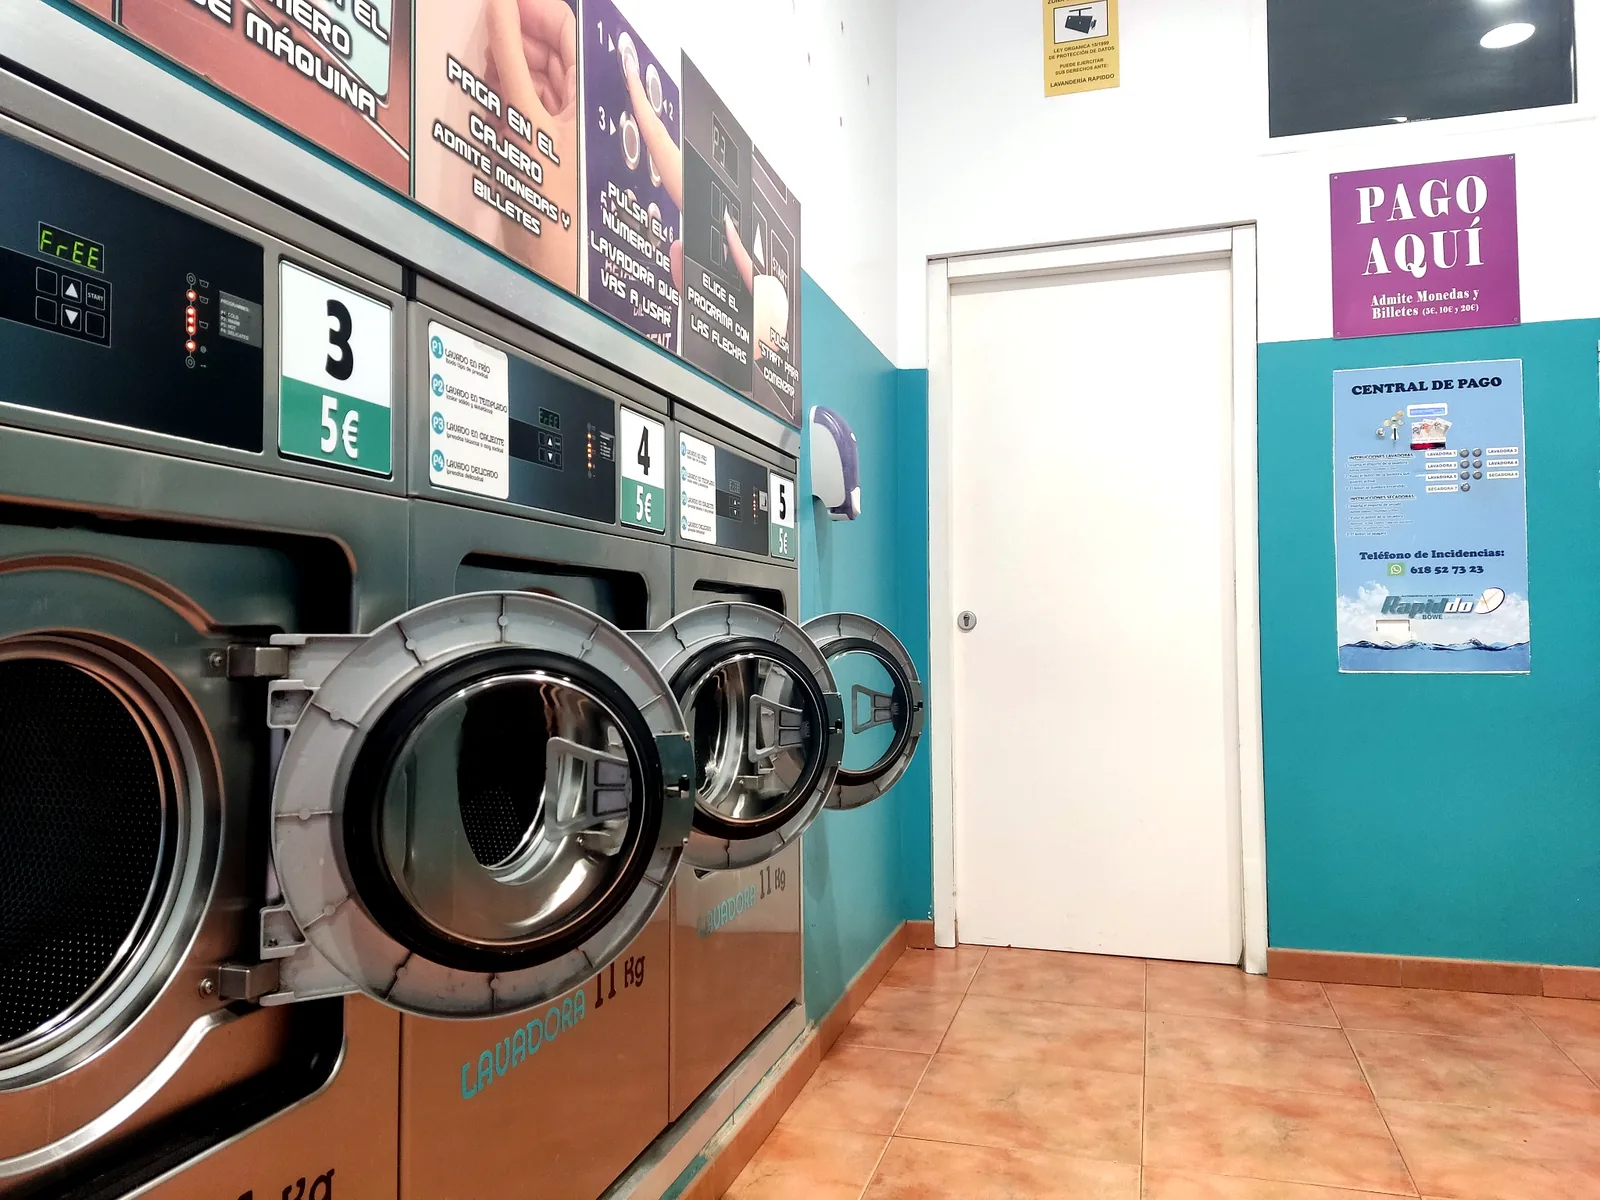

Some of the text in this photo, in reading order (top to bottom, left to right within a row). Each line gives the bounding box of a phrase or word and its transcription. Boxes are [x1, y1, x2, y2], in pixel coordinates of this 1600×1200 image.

[353, 0, 388, 41] EL
[597, 20, 603, 45] 1
[246, 12, 376, 118] MÁQUINA
[1056, 49, 1089, 59] PROTECCIÓN
[1098, 45, 1115, 53] DATOS
[1059, 58, 1104, 69] PUEDE EJERCITAR
[1065, 65, 1094, 74] DERECHOS
[1050, 73, 1115, 88] LAVANDERÍA RAPIDDO
[447, 57, 561, 165] PAGA EN EL
[598, 105, 606, 131] 3
[669, 101, 674, 122] 2
[469, 114, 543, 185] CAJERO
[433, 122, 571, 229] ADMITE MONEDAS Y
[473, 177, 542, 236] BILLETES
[608, 180, 667, 243] PULSA EL
[1355, 175, 1488, 225] PAGO
[40, 228, 100, 270] FrEE
[602, 207, 671, 274] NÚMERO DE
[1361, 216, 1485, 279] AQUÍ
[590, 230, 680, 307] LAVADORA QUE
[87, 291, 105, 302] START
[600, 268, 627, 300] VAS
[630, 288, 640, 308] A
[642, 295, 672, 329] USAR
[702, 272, 740, 313] ELIGE EL
[1370, 287, 1480, 307] Admite Monedas y
[1371, 305, 1419, 320] Billetes
[1439, 305, 1453, 315] 10€
[1454, 307, 1460, 315] y
[1460, 303, 1480, 313] 20€)
[687, 286, 751, 345] PROGRAMA CON
[324, 298, 355, 382] 3
[432, 339, 491, 374] P1 LAVADO EN FRÍO
[690, 315, 748, 366] LAS FLECHAS
[770, 325, 790, 354] PULSA
[763, 366, 797, 399] COMENZAR
[785, 359, 800, 382] PARA
[1351, 376, 1503, 396] CENTRAL DE PAGO
[432, 378, 444, 394] P2
[446, 384, 470, 400] LAVADO
[470, 392, 479, 403] EN
[478, 395, 508, 414] TEMPLADO
[319, 394, 360, 460] 5€
[432, 416, 505, 447] P3 LAVADO EN CALIENTE
[432, 453, 500, 480] P4 LAVADO DELICADO
[637, 425, 651, 476] 4
[635, 484, 653, 524] 5€
[779, 483, 787, 521] 5
[779, 527, 789, 556] 5€
[1359, 548, 1505, 561] Teléfono de Incidencias:
[1410, 564, 1485, 575] 618 52 73 23
[1380, 595, 1475, 619] Rapiddo
[697, 865, 786, 938] LAVADORA 11 Kg
[461, 955, 646, 1100] LAVADORA 11 Kg
